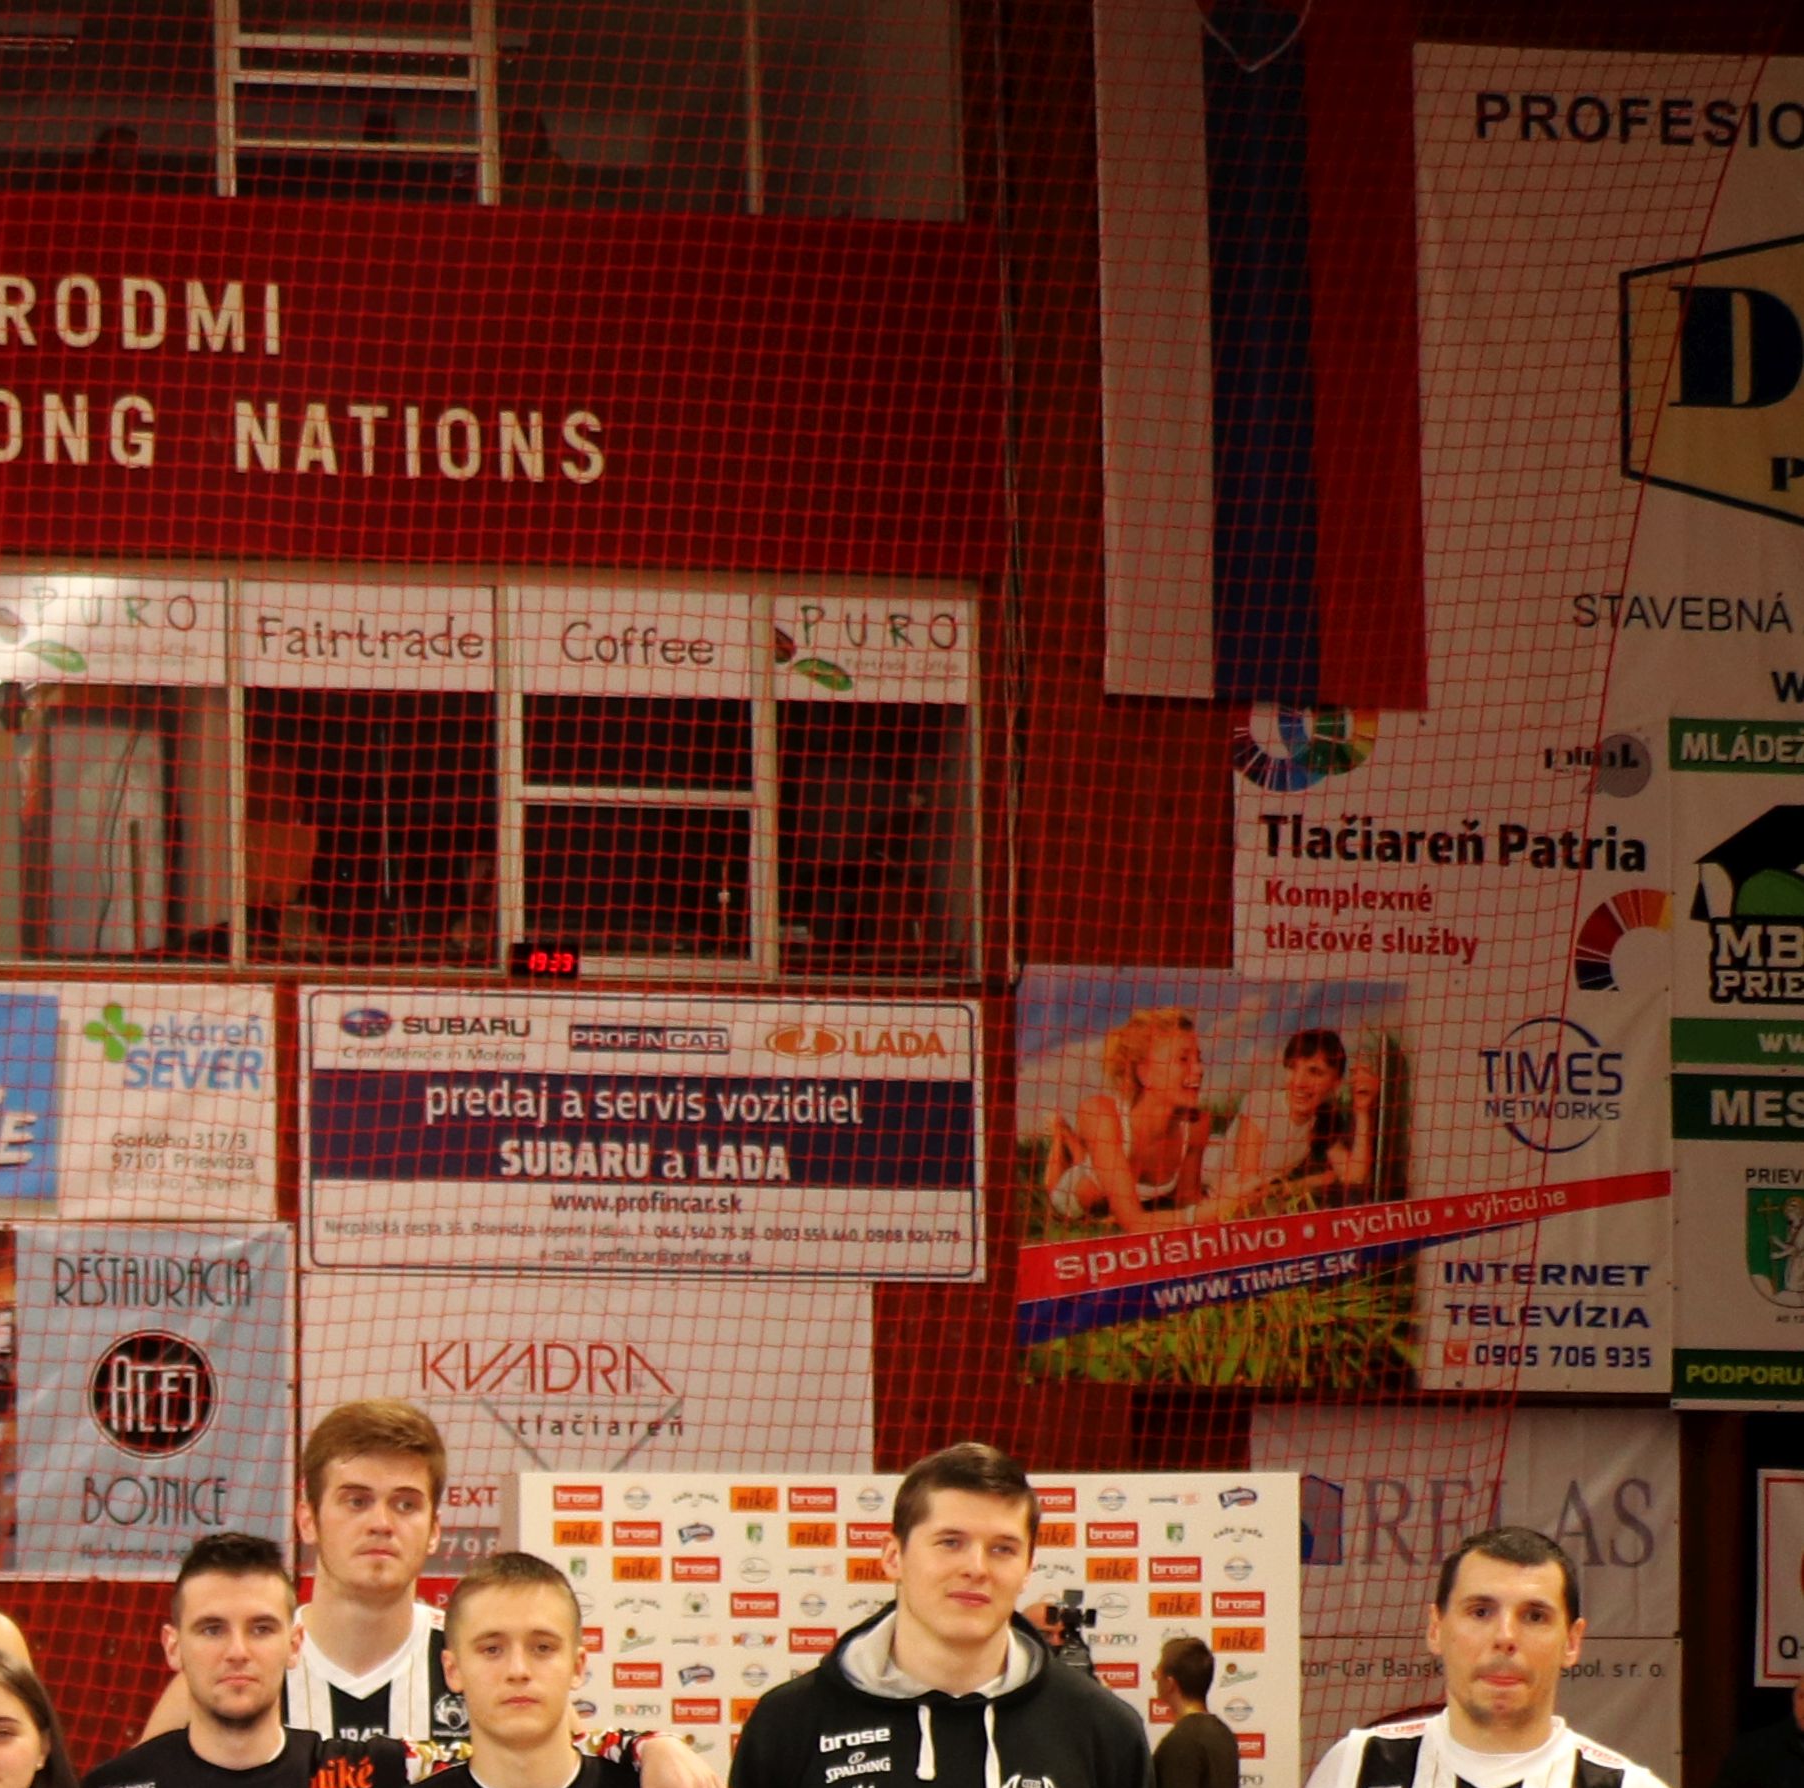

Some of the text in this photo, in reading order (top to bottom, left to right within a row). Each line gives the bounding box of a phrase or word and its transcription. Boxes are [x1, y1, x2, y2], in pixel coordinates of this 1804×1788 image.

[234, 400, 606, 484] NATIONS
[800, 604, 958, 650] PURO
[1572, 592, 1793, 633] STAVEBNÁ
[260, 615, 485, 663] Fairtrade
[561, 620, 714, 666] Coffee
[1258, 813, 1647, 872] Tlačiareň Patria
[1264, 878, 1433, 916] Komplexné
[1265, 920, 1479, 963] tlačové služby
[402, 1015, 531, 1038] SUBARU
[854, 1031, 946, 1059] LADA
[124, 1048, 263, 1090] SEVER
[1479, 1048, 1624, 1097] TIMES
[424, 1081, 863, 1126] predaj a servis vozidiel
[1485, 1099, 1621, 1122] NETWORKS
[499, 1140, 791, 1182] SUBARU a LADA
[551, 1192, 743, 1217] www.profincar.sk
[1053, 1187, 1568, 1284] spoľahlivo rýchlo výhodne
[1444, 1264, 1651, 1287] INTERNET
[1445, 1299, 1651, 1330] TELEVÍZIA
[419, 1341, 676, 1395] KVADRA
[1475, 1345, 1541, 1368] 0905
[1606, 1347, 1652, 1368] 935
[517, 1412, 685, 1438] tlačiareň
[81, 1474, 228, 1528] BOJNICE
[819, 1726, 891, 1753] brose
[825, 1756, 891, 1784] SPALDING
